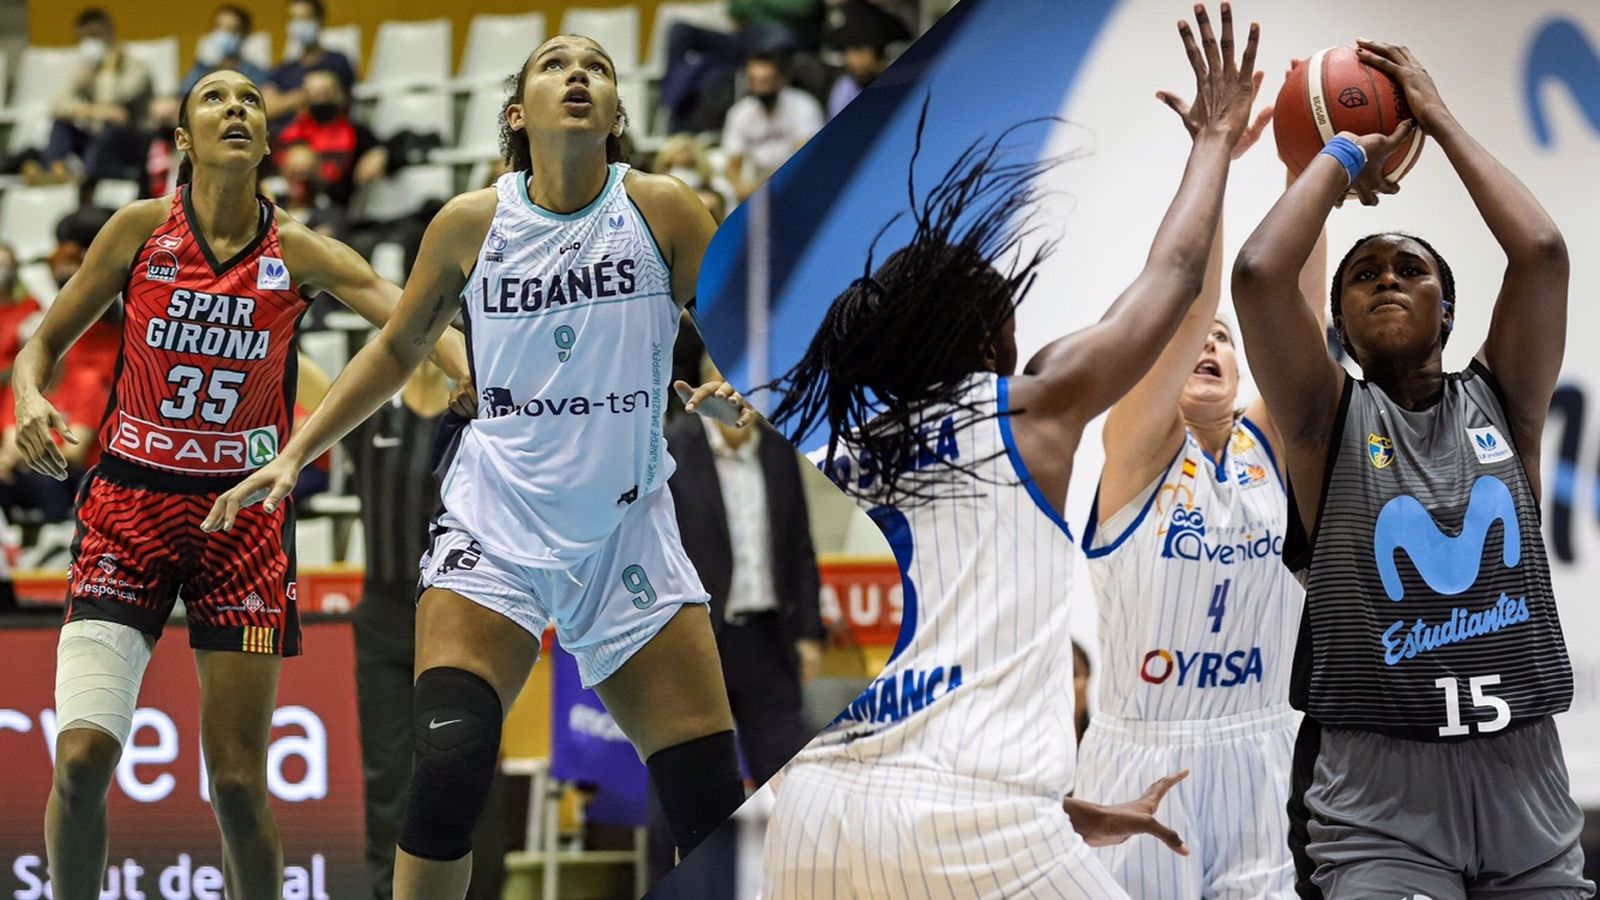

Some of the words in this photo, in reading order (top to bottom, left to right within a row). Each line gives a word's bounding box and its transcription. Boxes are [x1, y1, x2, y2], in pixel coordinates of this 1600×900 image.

[150, 265, 176, 276] UNI
[483, 255, 636, 313] LEGANÉS
[167, 289, 256, 327] SPAR
[146, 318, 269, 359] GIRONA
[554, 325, 576, 362] 9
[160, 365, 247, 424] 35
[119, 421, 244, 463] SPAR
[622, 564, 657, 610] 9
[1208, 579, 1231, 632] 4
[1382, 592, 1530, 665] Estudiantes
[1140, 647, 1263, 688] OYRSA
[1435, 674, 1511, 737] 15
